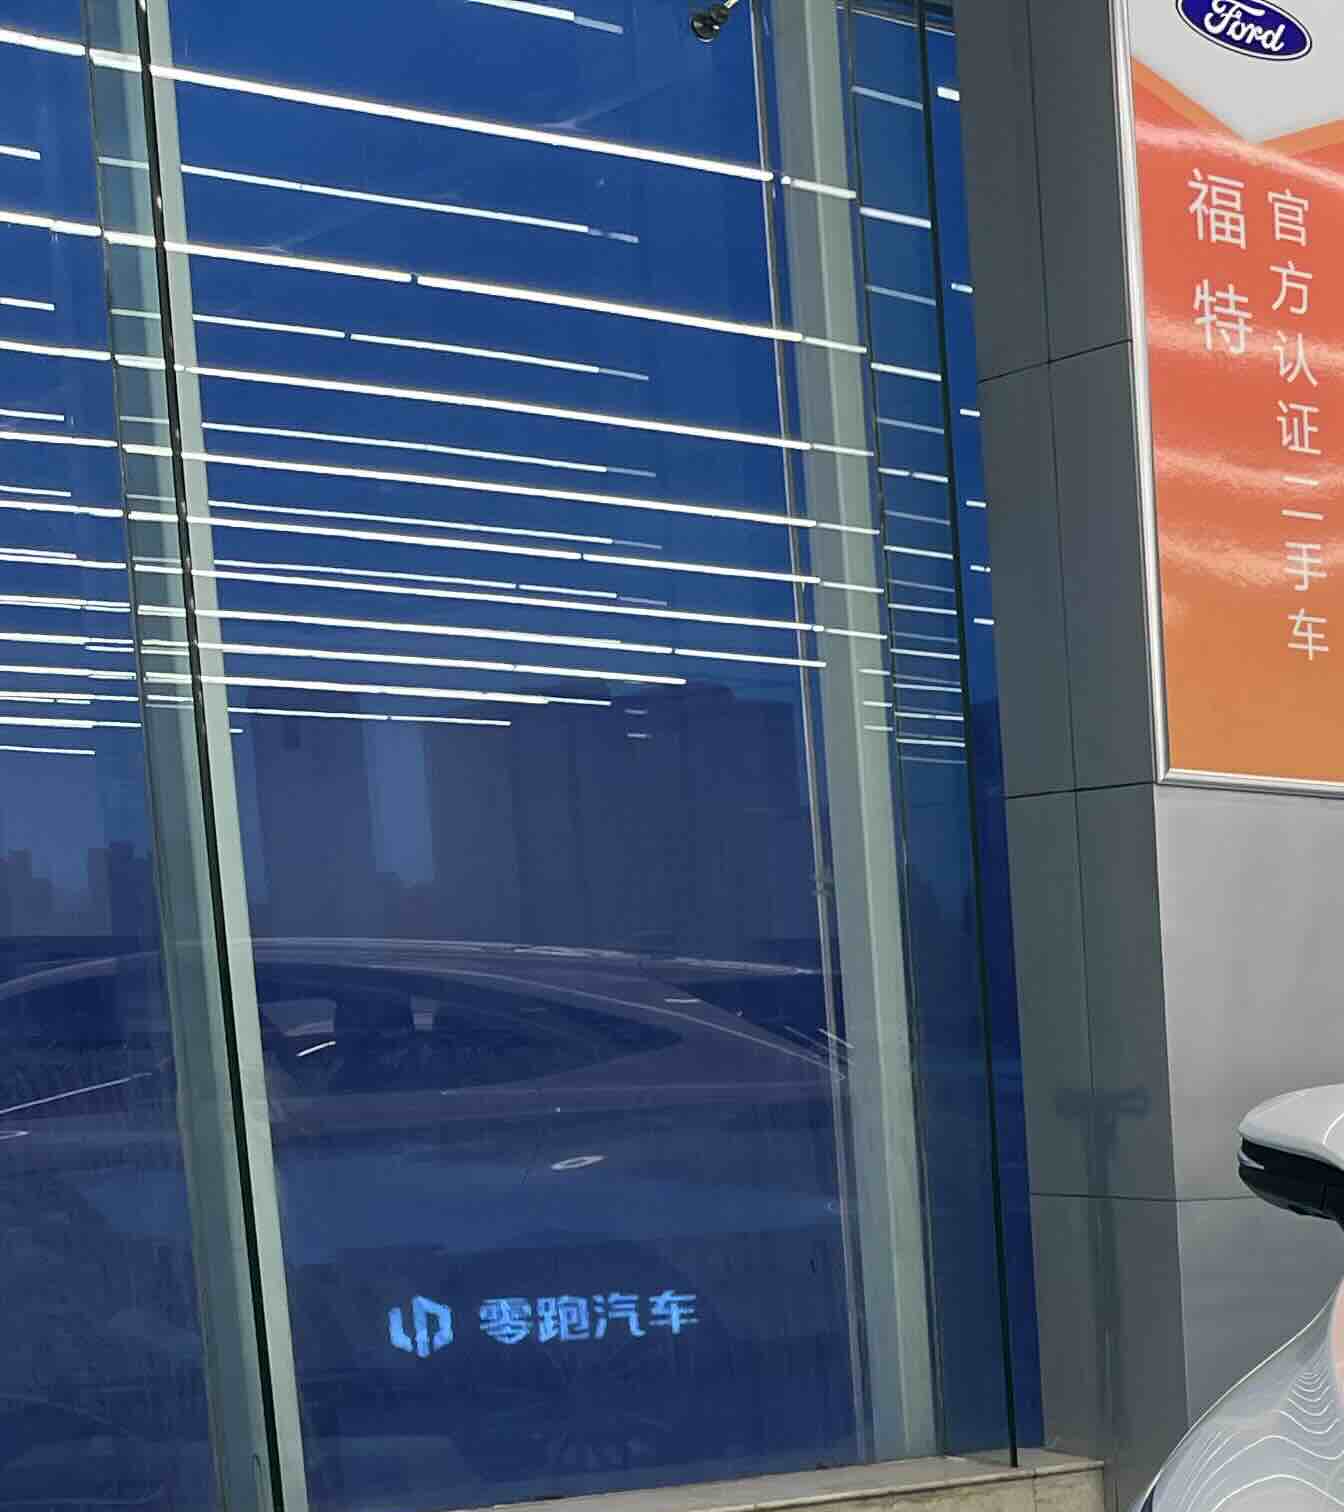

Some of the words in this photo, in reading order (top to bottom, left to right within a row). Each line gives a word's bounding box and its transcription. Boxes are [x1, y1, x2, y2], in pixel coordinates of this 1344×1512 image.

[1204, 0, 1285, 52] Ford
[1187, 167, 1252, 355] 福特
[1267, 188, 1329, 661] 官方认证二手车
[479, 1290, 699, 1344] 零跑汽车
